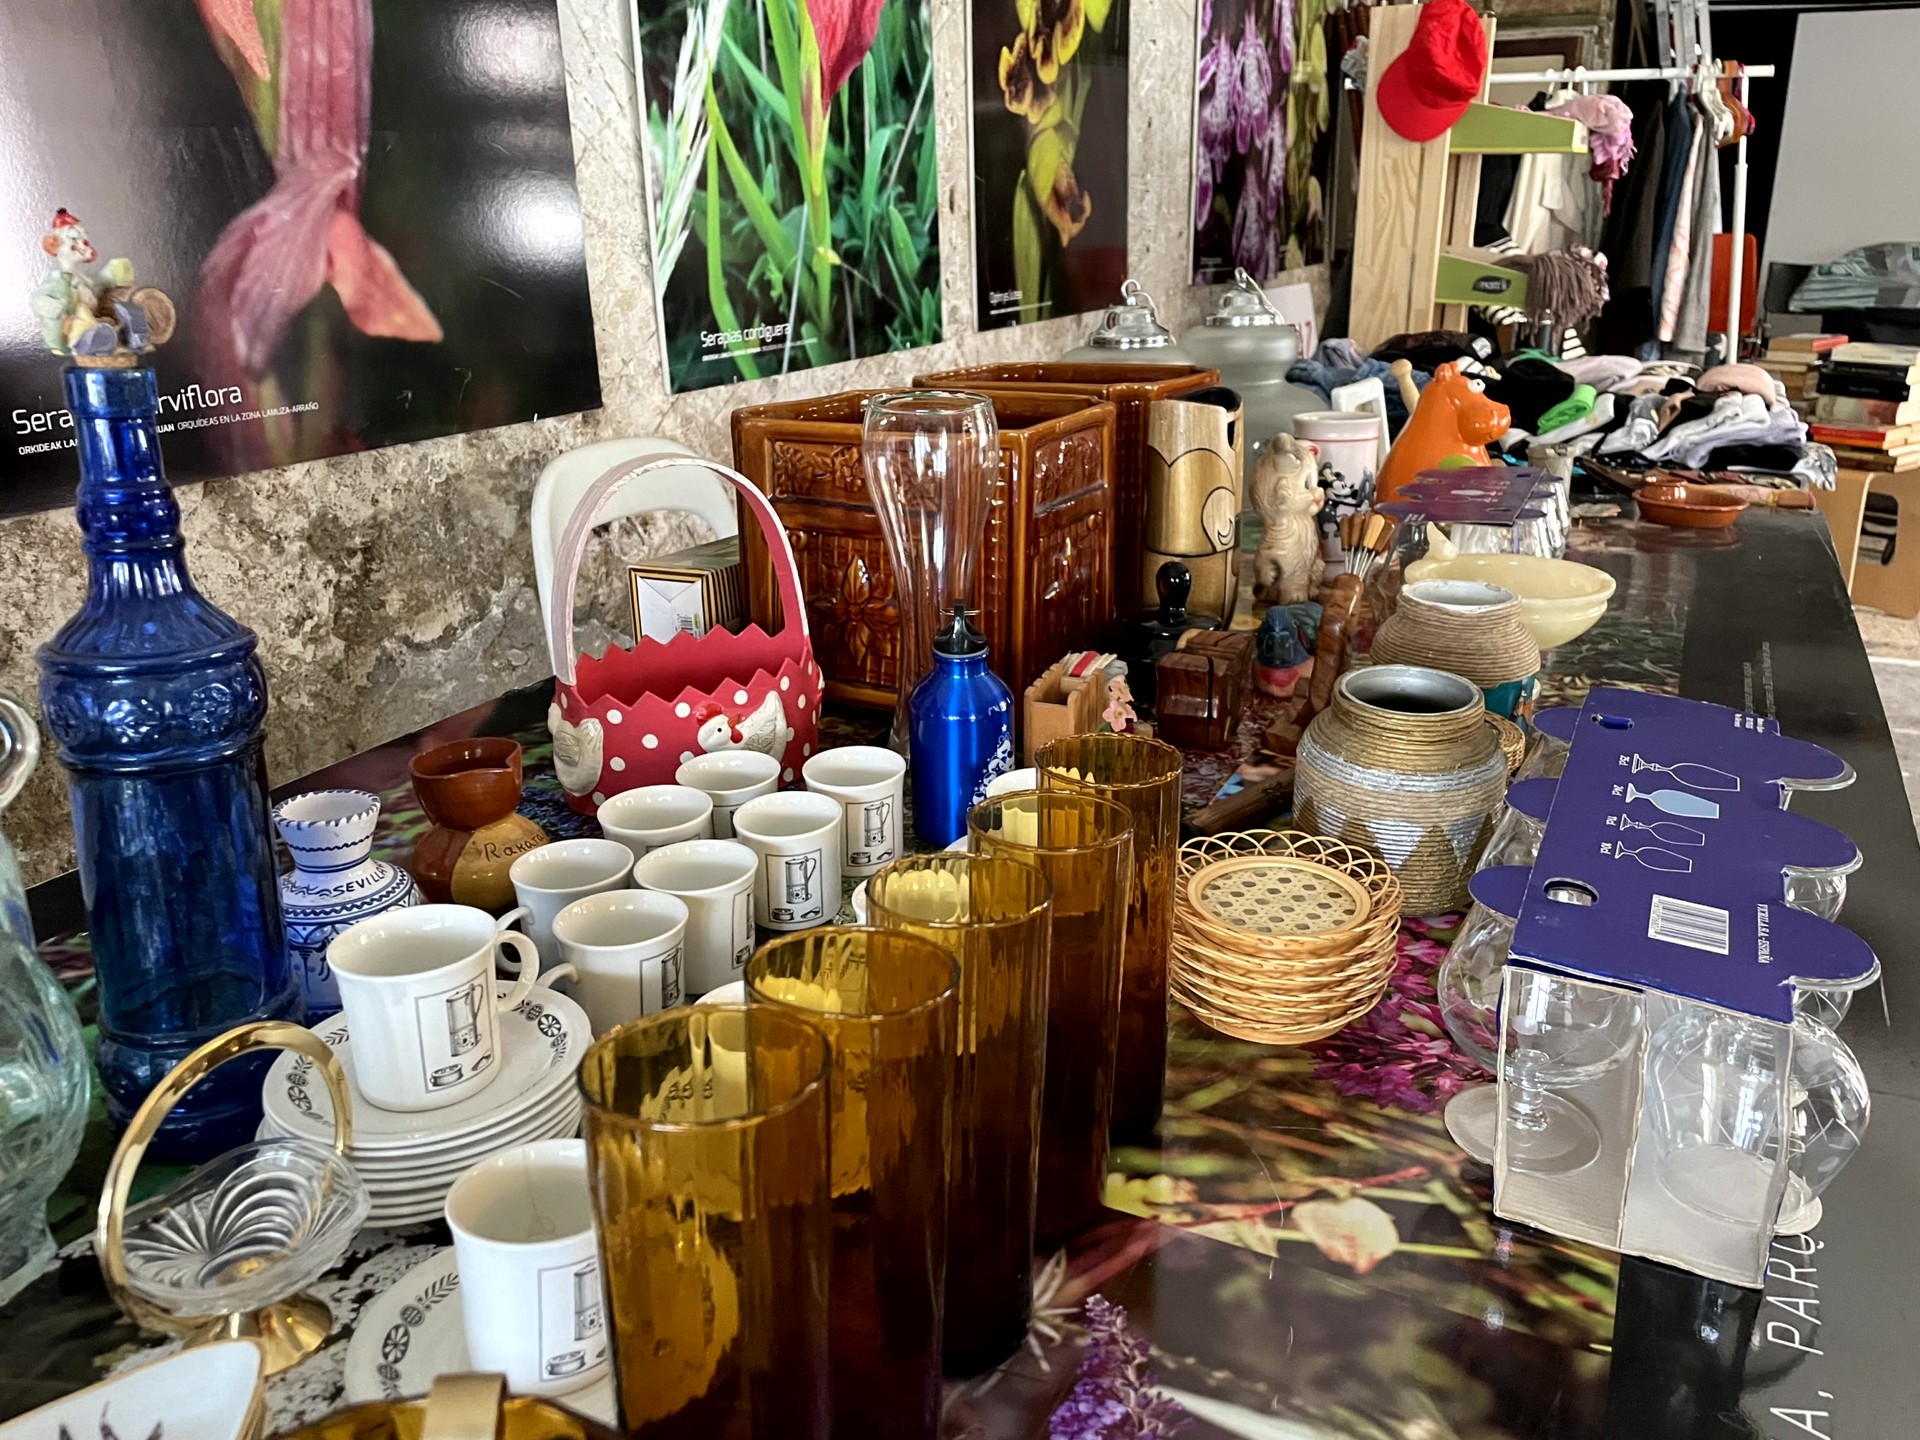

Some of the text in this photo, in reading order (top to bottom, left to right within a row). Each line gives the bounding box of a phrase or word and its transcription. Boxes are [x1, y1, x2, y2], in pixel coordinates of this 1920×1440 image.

[700, 328, 743, 349] Serapias
[743, 322, 792, 342] cordiguera
[12, 383, 242, 434] Sera rviflora
[18, 440, 62, 456] ORKIDEAK
[177, 415, 219, 431] ORQUÍDEAS
[219, 414, 230, 424] EN
[230, 412, 241, 422] LA
[241, 410, 261, 421] ZONA
[331, 863, 388, 898] SEVILLA
